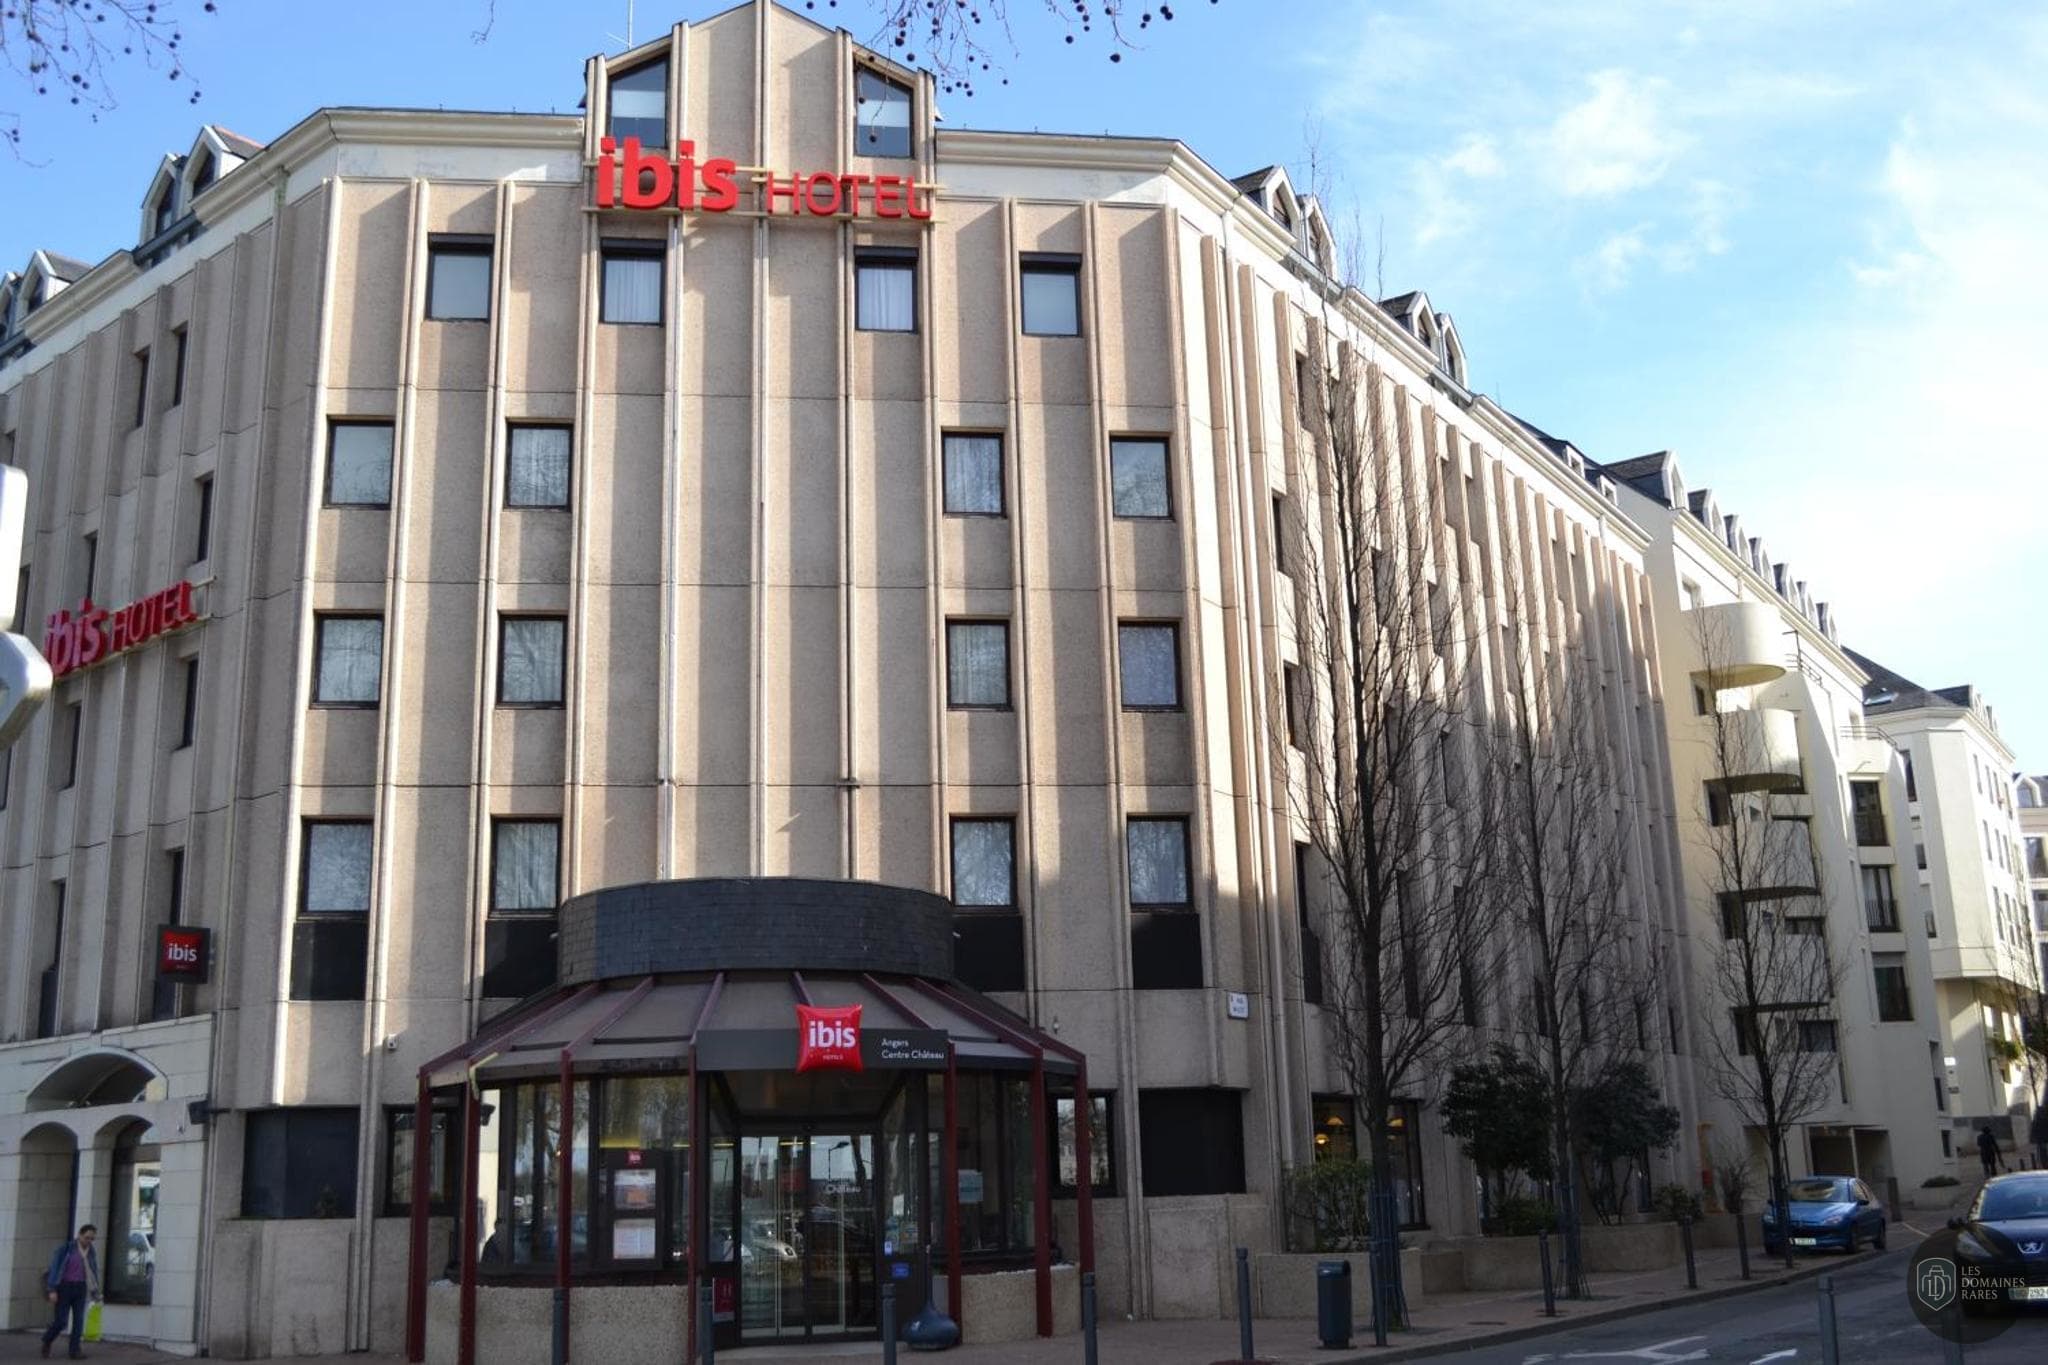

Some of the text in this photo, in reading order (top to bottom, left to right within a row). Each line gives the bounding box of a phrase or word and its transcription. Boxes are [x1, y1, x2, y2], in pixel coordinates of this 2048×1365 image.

[597, 136, 932, 219] ibis HOTEL
[43, 580, 198, 677] ibis HOTEL
[168, 942, 198, 962] ibis
[809, 1021, 856, 1048] ibis
[881, 1050, 945, 1060] Centre Château
